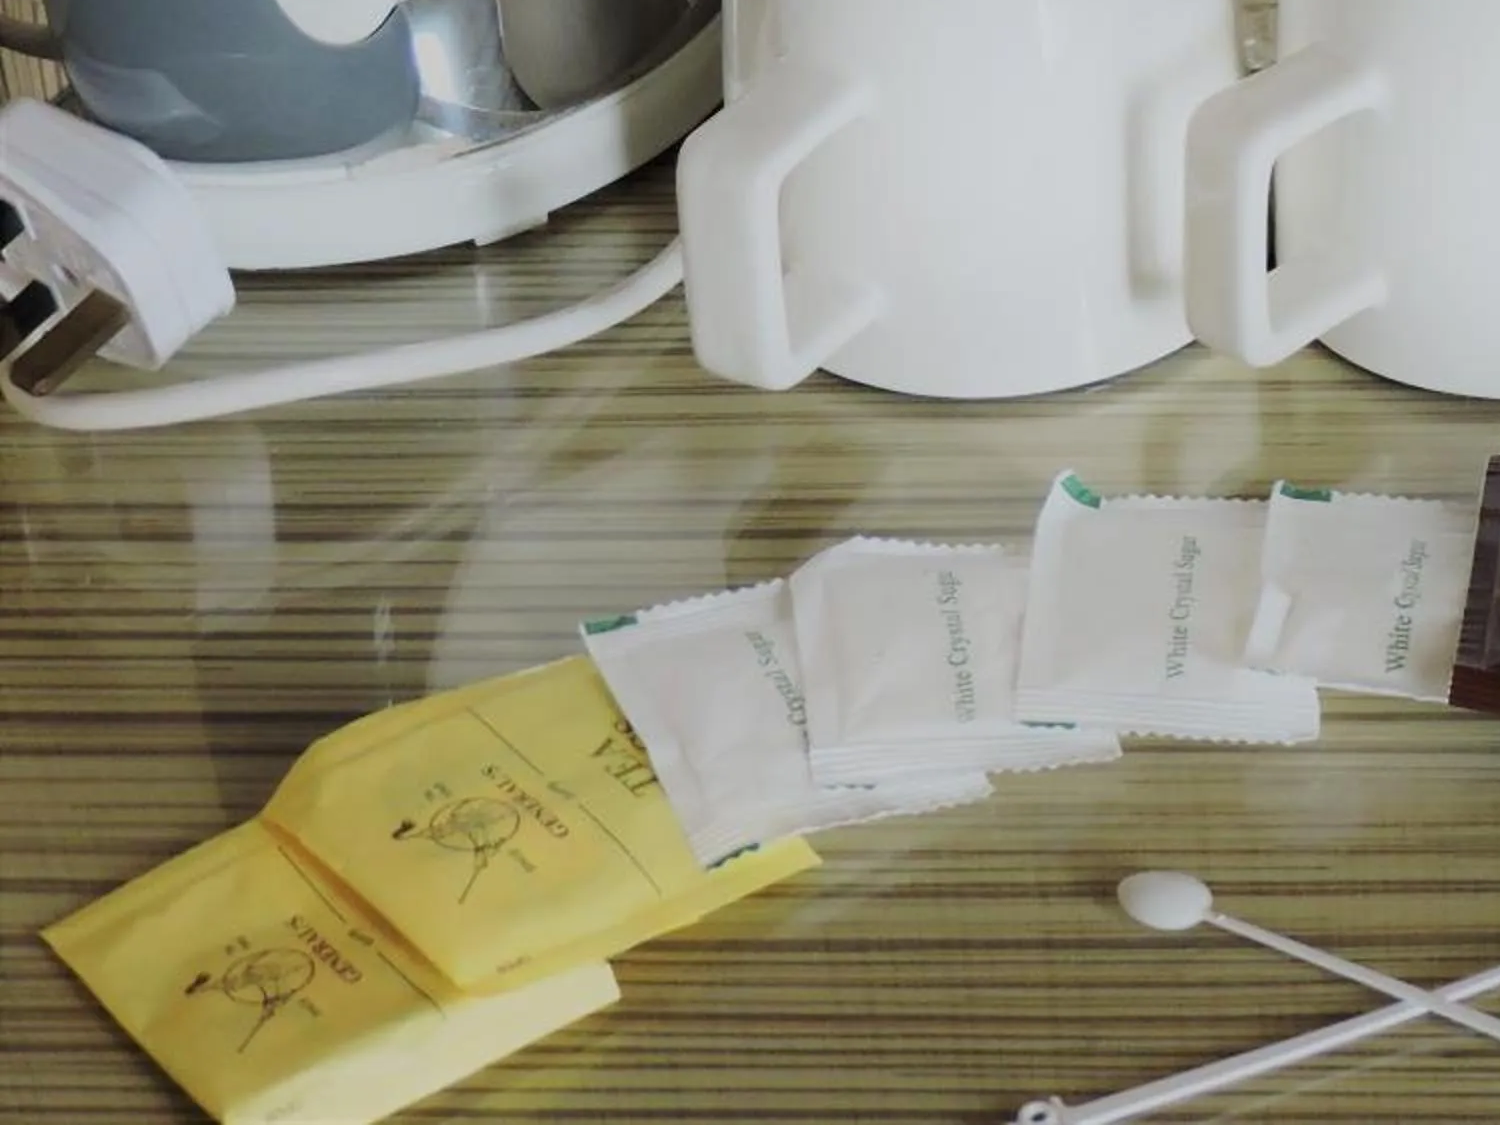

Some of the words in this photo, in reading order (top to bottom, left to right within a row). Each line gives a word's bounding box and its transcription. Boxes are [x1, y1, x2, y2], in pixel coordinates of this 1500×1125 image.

[1166, 625, 1189, 680] White
[1383, 615, 1412, 673] White
[954, 671, 976, 724] White
[590, 737, 658, 797] TEA
